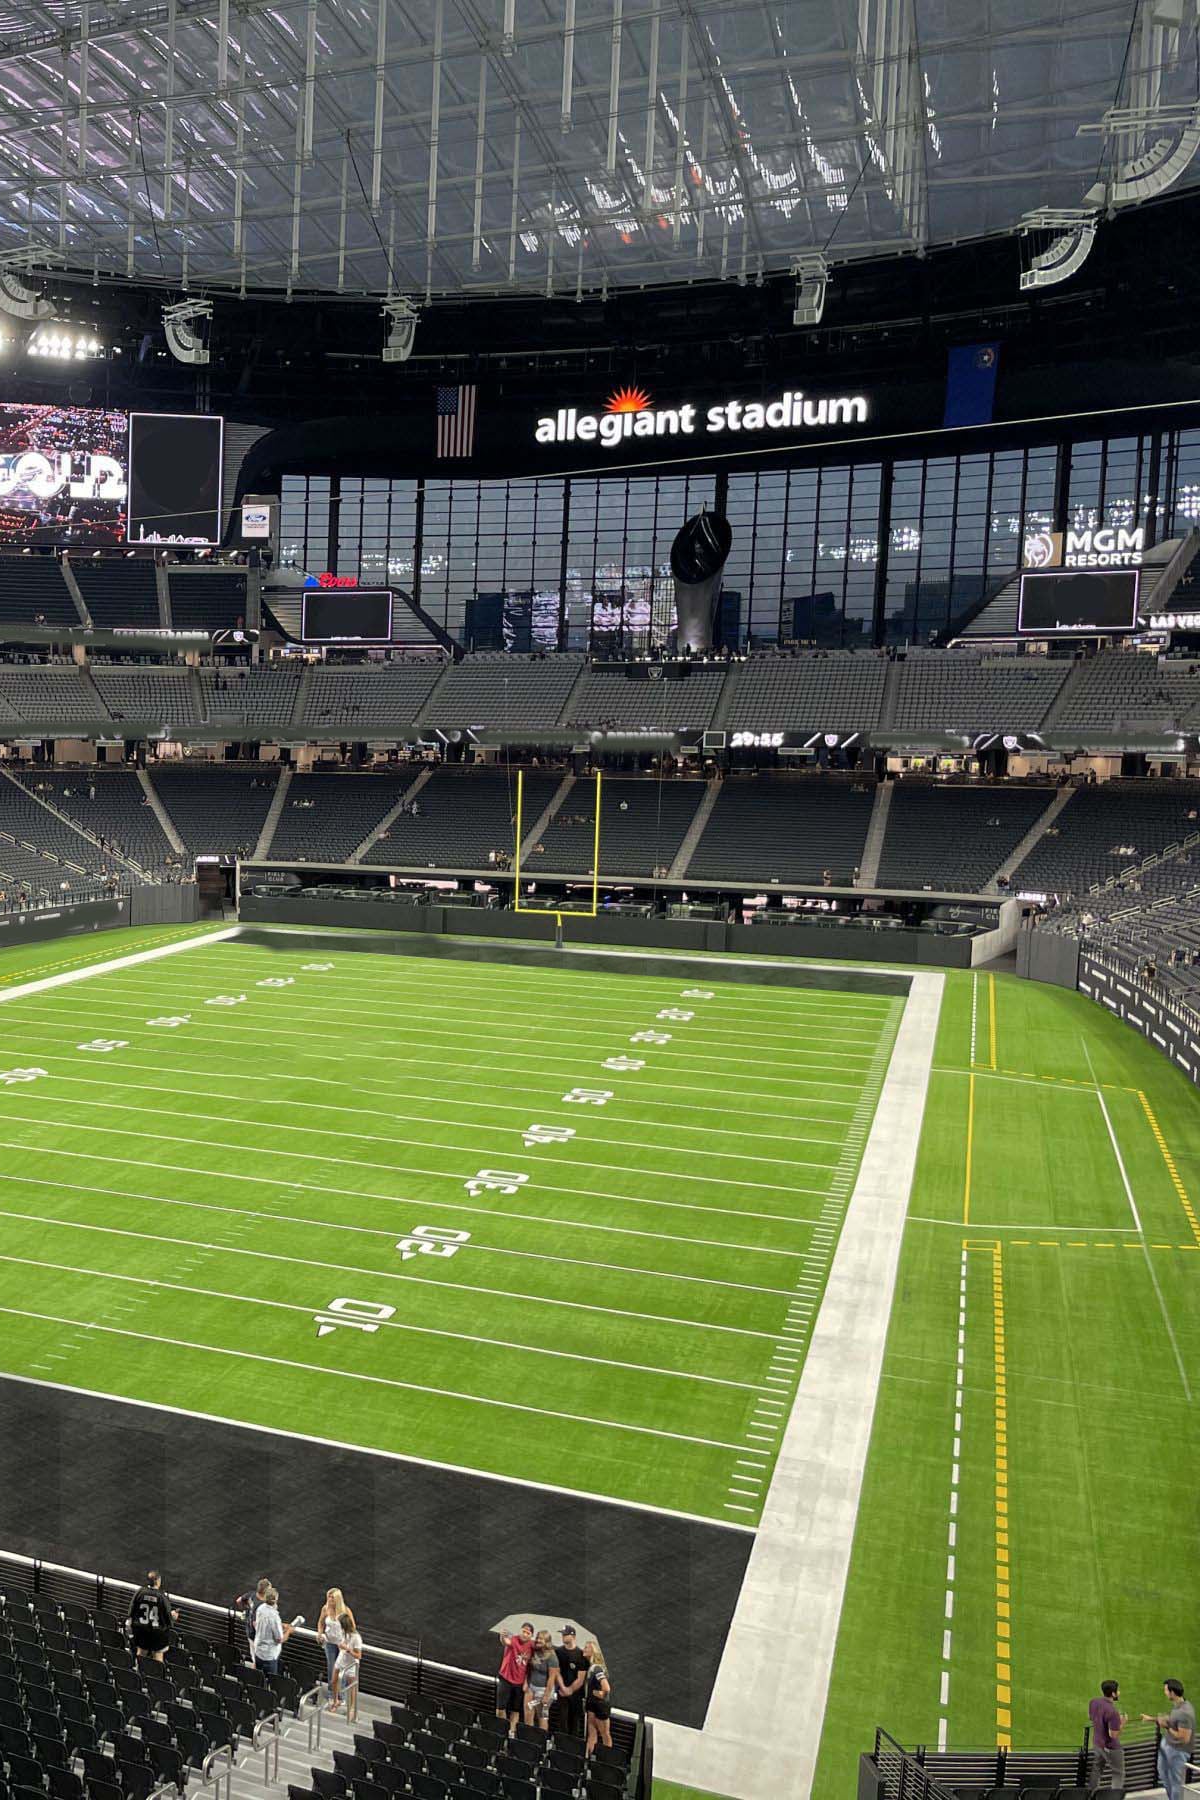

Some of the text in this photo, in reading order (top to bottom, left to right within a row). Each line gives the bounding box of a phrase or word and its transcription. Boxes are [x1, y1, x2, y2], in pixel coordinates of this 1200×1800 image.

[535, 392, 867, 446] allegiant stadium
[1066, 528, 1144, 552] MGM
[1065, 552, 1143, 567] RESORTS
[464, 1169, 529, 1194] 30
[396, 1225, 471, 1258] 20
[314, 1298, 397, 1333] 10
[139, 1603, 159, 1627] 34
